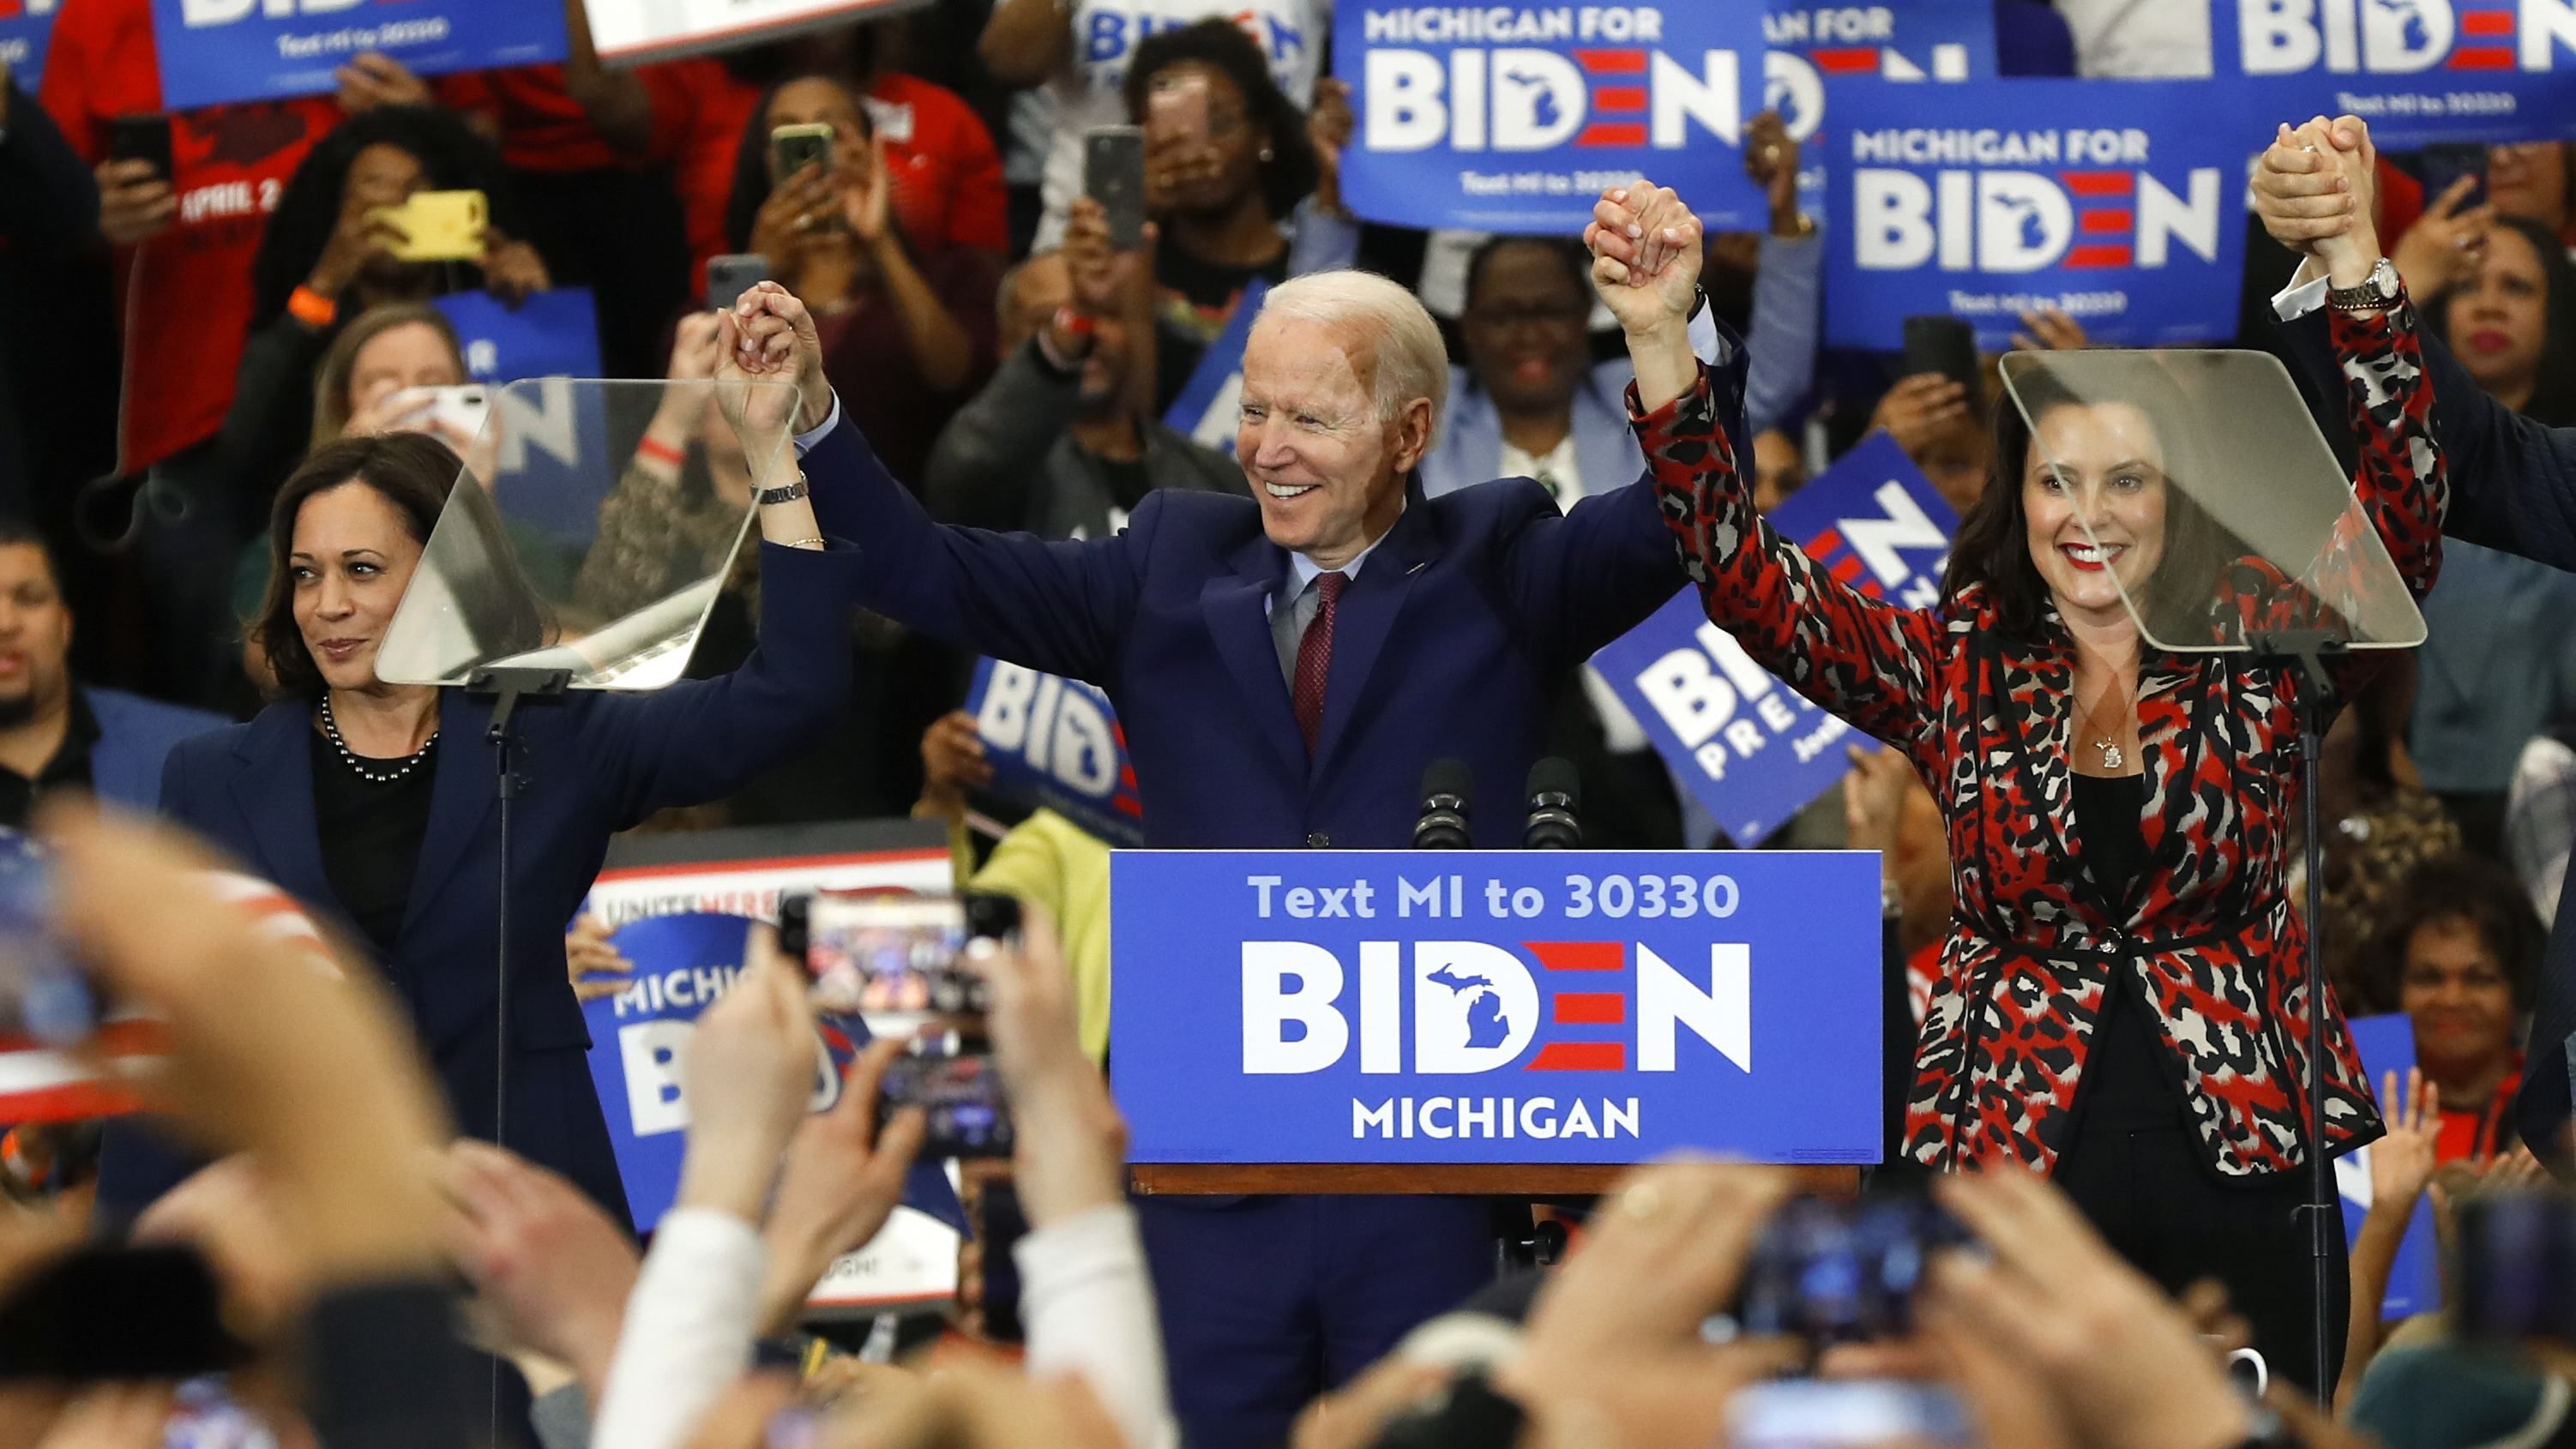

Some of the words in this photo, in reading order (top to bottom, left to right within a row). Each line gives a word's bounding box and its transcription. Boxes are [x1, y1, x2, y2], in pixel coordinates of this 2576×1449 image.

[1364, 6, 1574, 43] MICHIGAN
[1580, 6, 1664, 41] FOR
[1814, 6, 1894, 41] FOR
[1364, 48, 1741, 152] BIDEN
[1852, 129, 2061, 164] MICHIGAN
[2066, 129, 2150, 163] FOR
[181, 181, 254, 222] APRIL
[1853, 169, 2221, 272] BIDEN
[1248, 875, 1375, 918] Text
[1399, 875, 1462, 918] MI
[1485, 879, 1544, 918] to
[1565, 875, 1740, 918] 30330
[1242, 941, 1751, 1074] BIDEN
[1352, 1097, 1640, 1139] MICHIGAN
